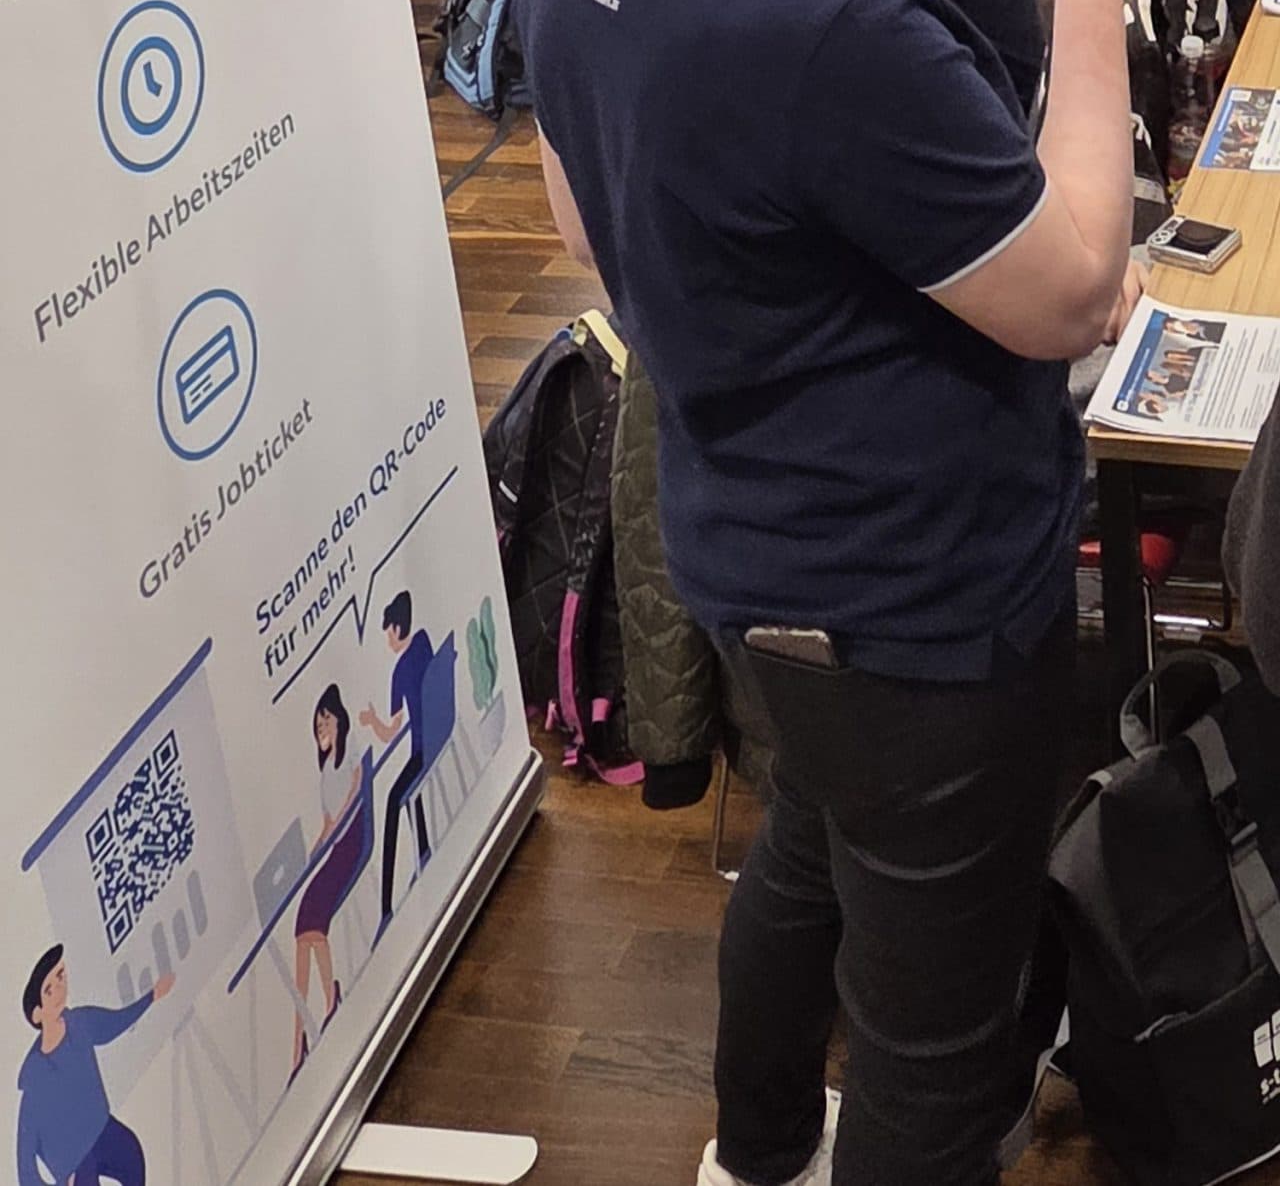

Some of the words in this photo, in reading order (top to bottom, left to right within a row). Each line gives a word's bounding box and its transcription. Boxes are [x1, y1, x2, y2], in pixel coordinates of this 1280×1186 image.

[34, 239, 141, 343] Flexible
[147, 113, 295, 252] Arbeitszeiten
[139, 510, 212, 598] Gratis
[217, 398, 312, 520] Jobticket
[256, 538, 328, 634] Scanne
[331, 492, 367, 543] den
[369, 398, 446, 496] QR-Code
[264, 626, 297, 677] für
[302, 545, 356, 636] mehr!
